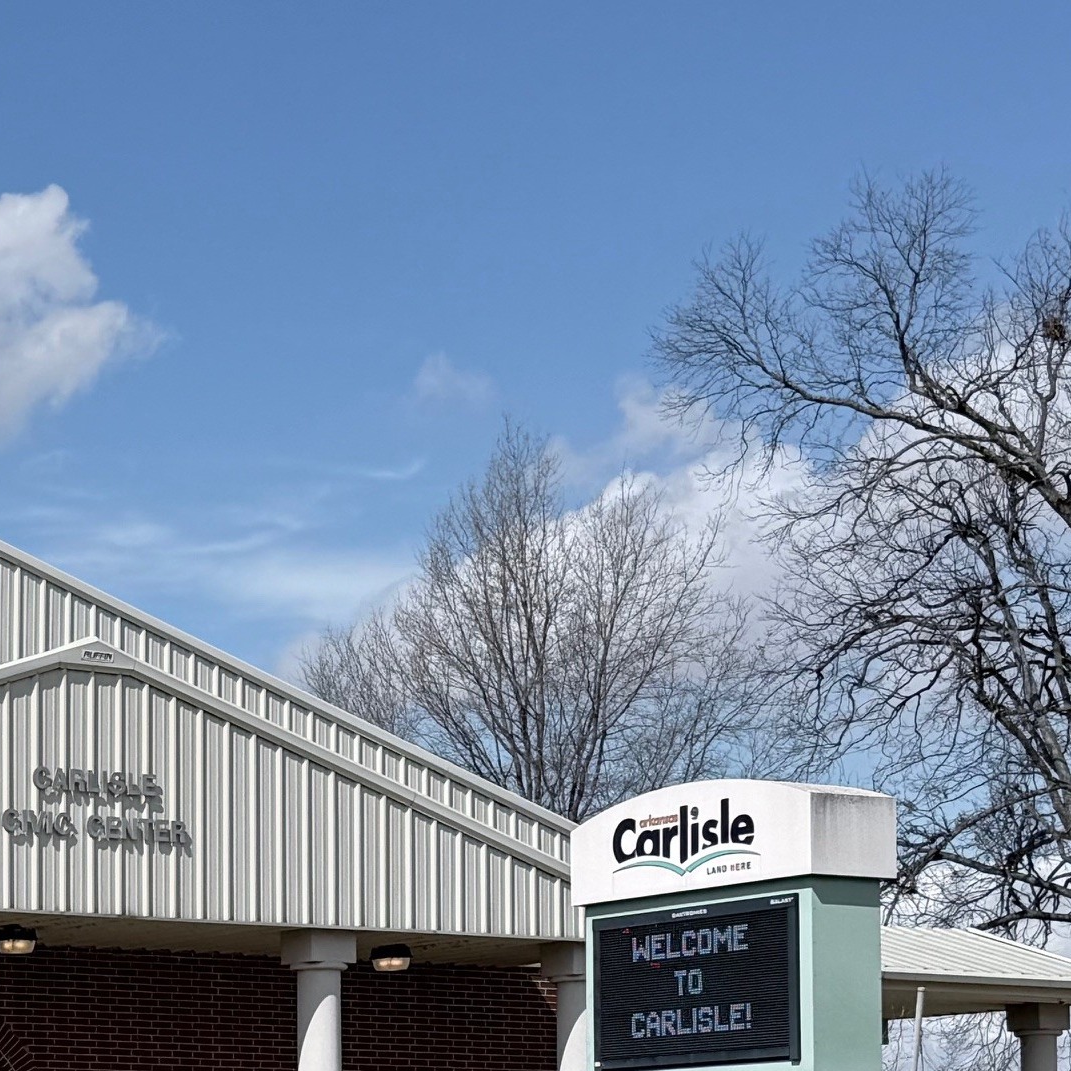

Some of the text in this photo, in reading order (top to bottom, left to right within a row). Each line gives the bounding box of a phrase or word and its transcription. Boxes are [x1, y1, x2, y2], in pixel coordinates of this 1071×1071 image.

[33, 766, 159, 798] CARLISLE
[2, 808, 188, 845] CIVIC CENTER
[613, 798, 754, 864] Carlisle
[639, 814, 678, 829] arkansas
[706, 865, 727, 875] LAND
[631, 924, 749, 963] WELCOME
[673, 968, 703, 996] TO
[631, 1002, 752, 1039] CARLISLE!
